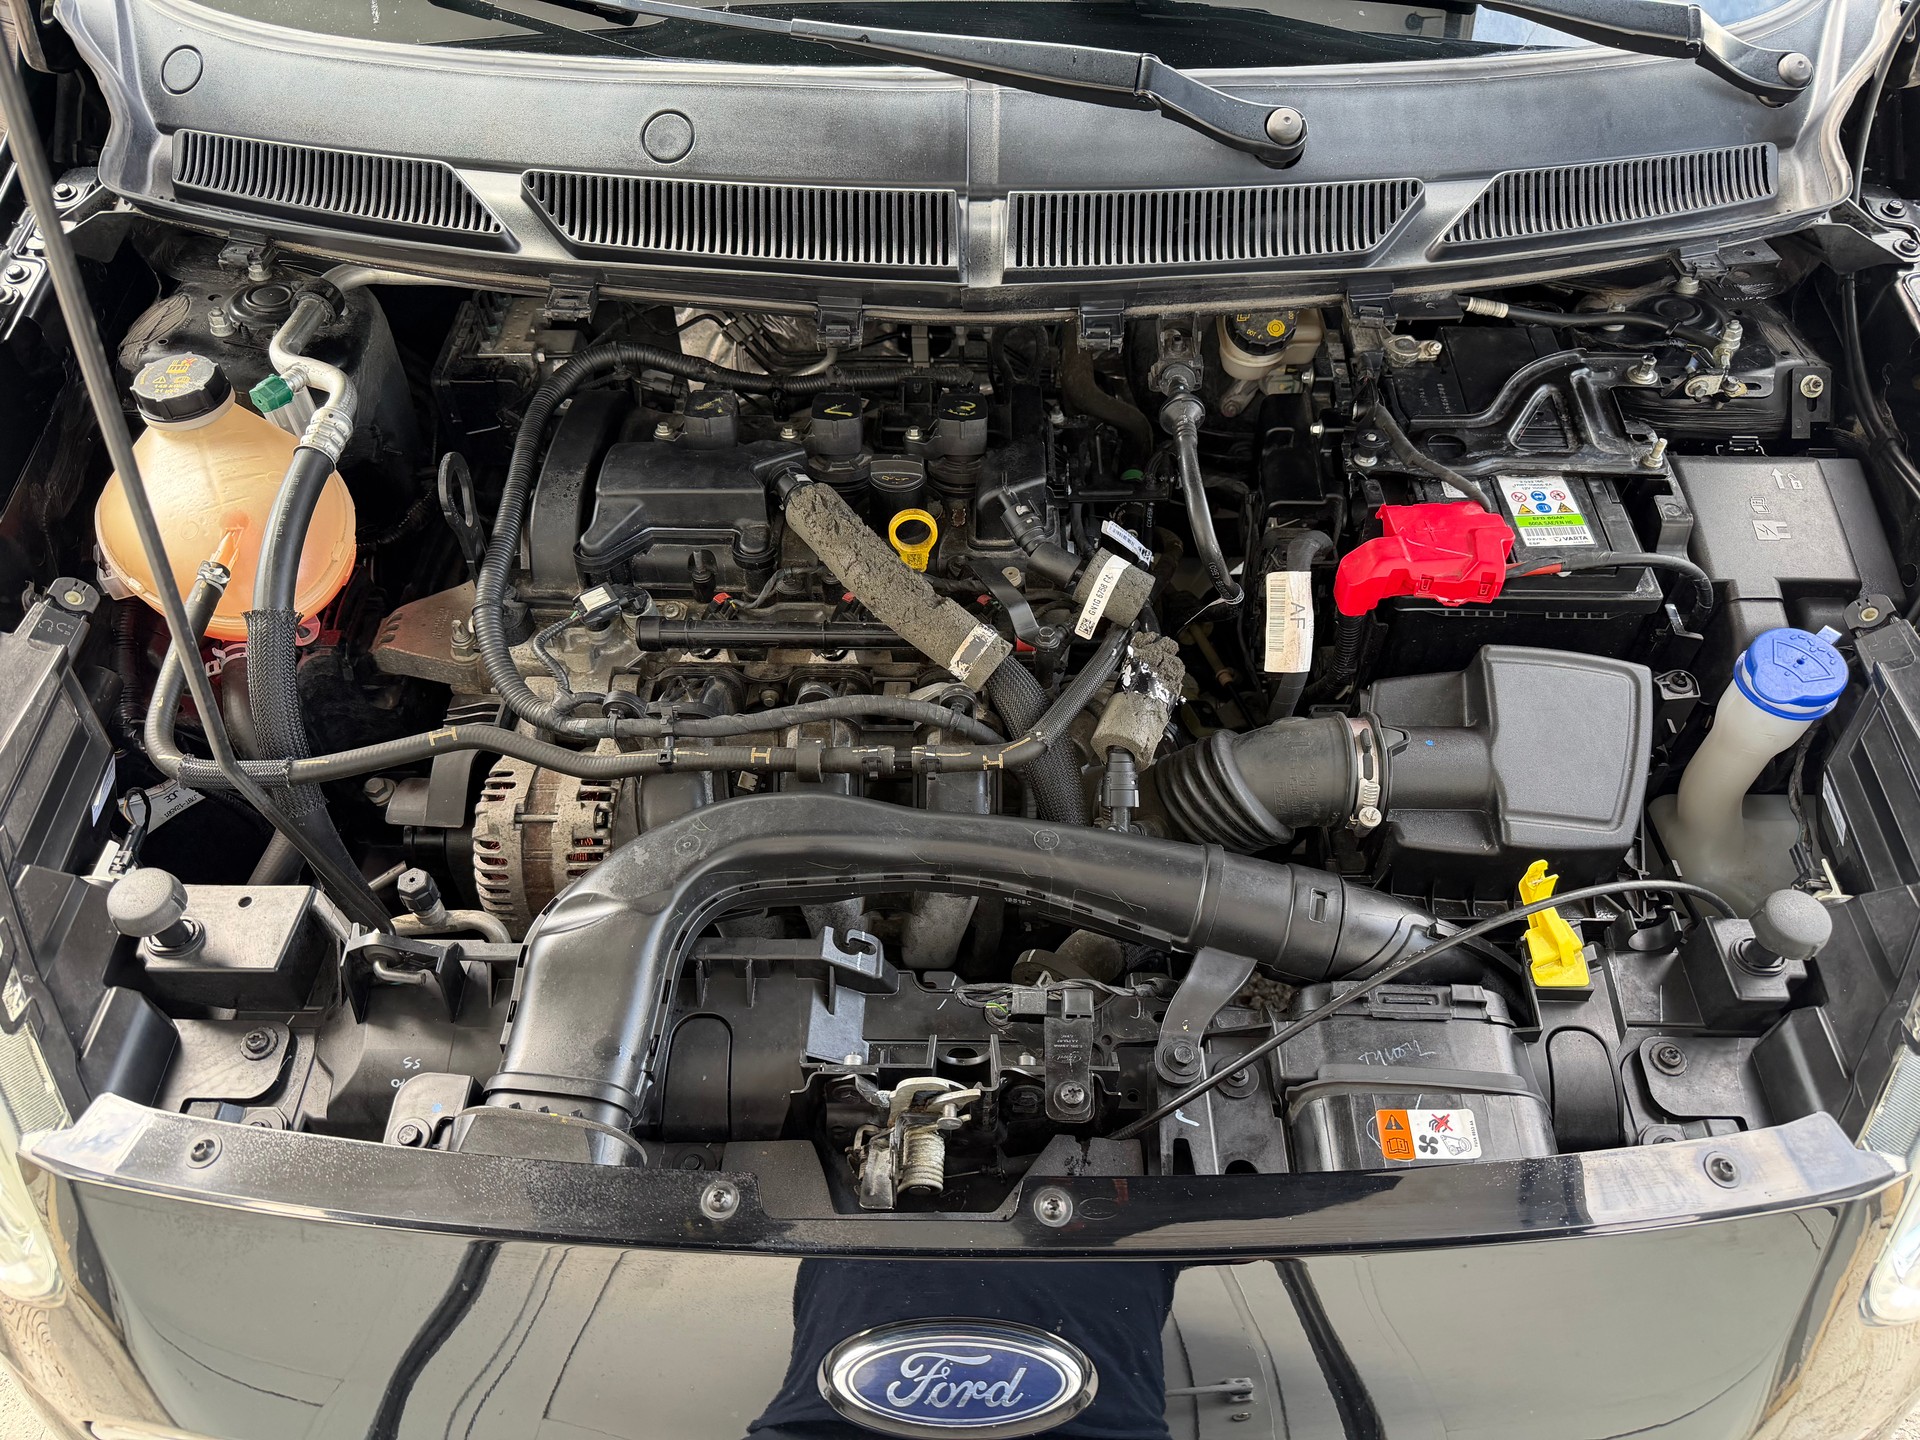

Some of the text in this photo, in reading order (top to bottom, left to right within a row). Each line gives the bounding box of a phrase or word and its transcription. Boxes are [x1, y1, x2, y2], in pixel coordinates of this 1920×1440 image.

[1089, 598, 1101, 616] GN1G
[1095, 584, 1108, 599] 6758
[1290, 601, 1306, 630] AF
[886, 1352, 1027, 1408] Ford
